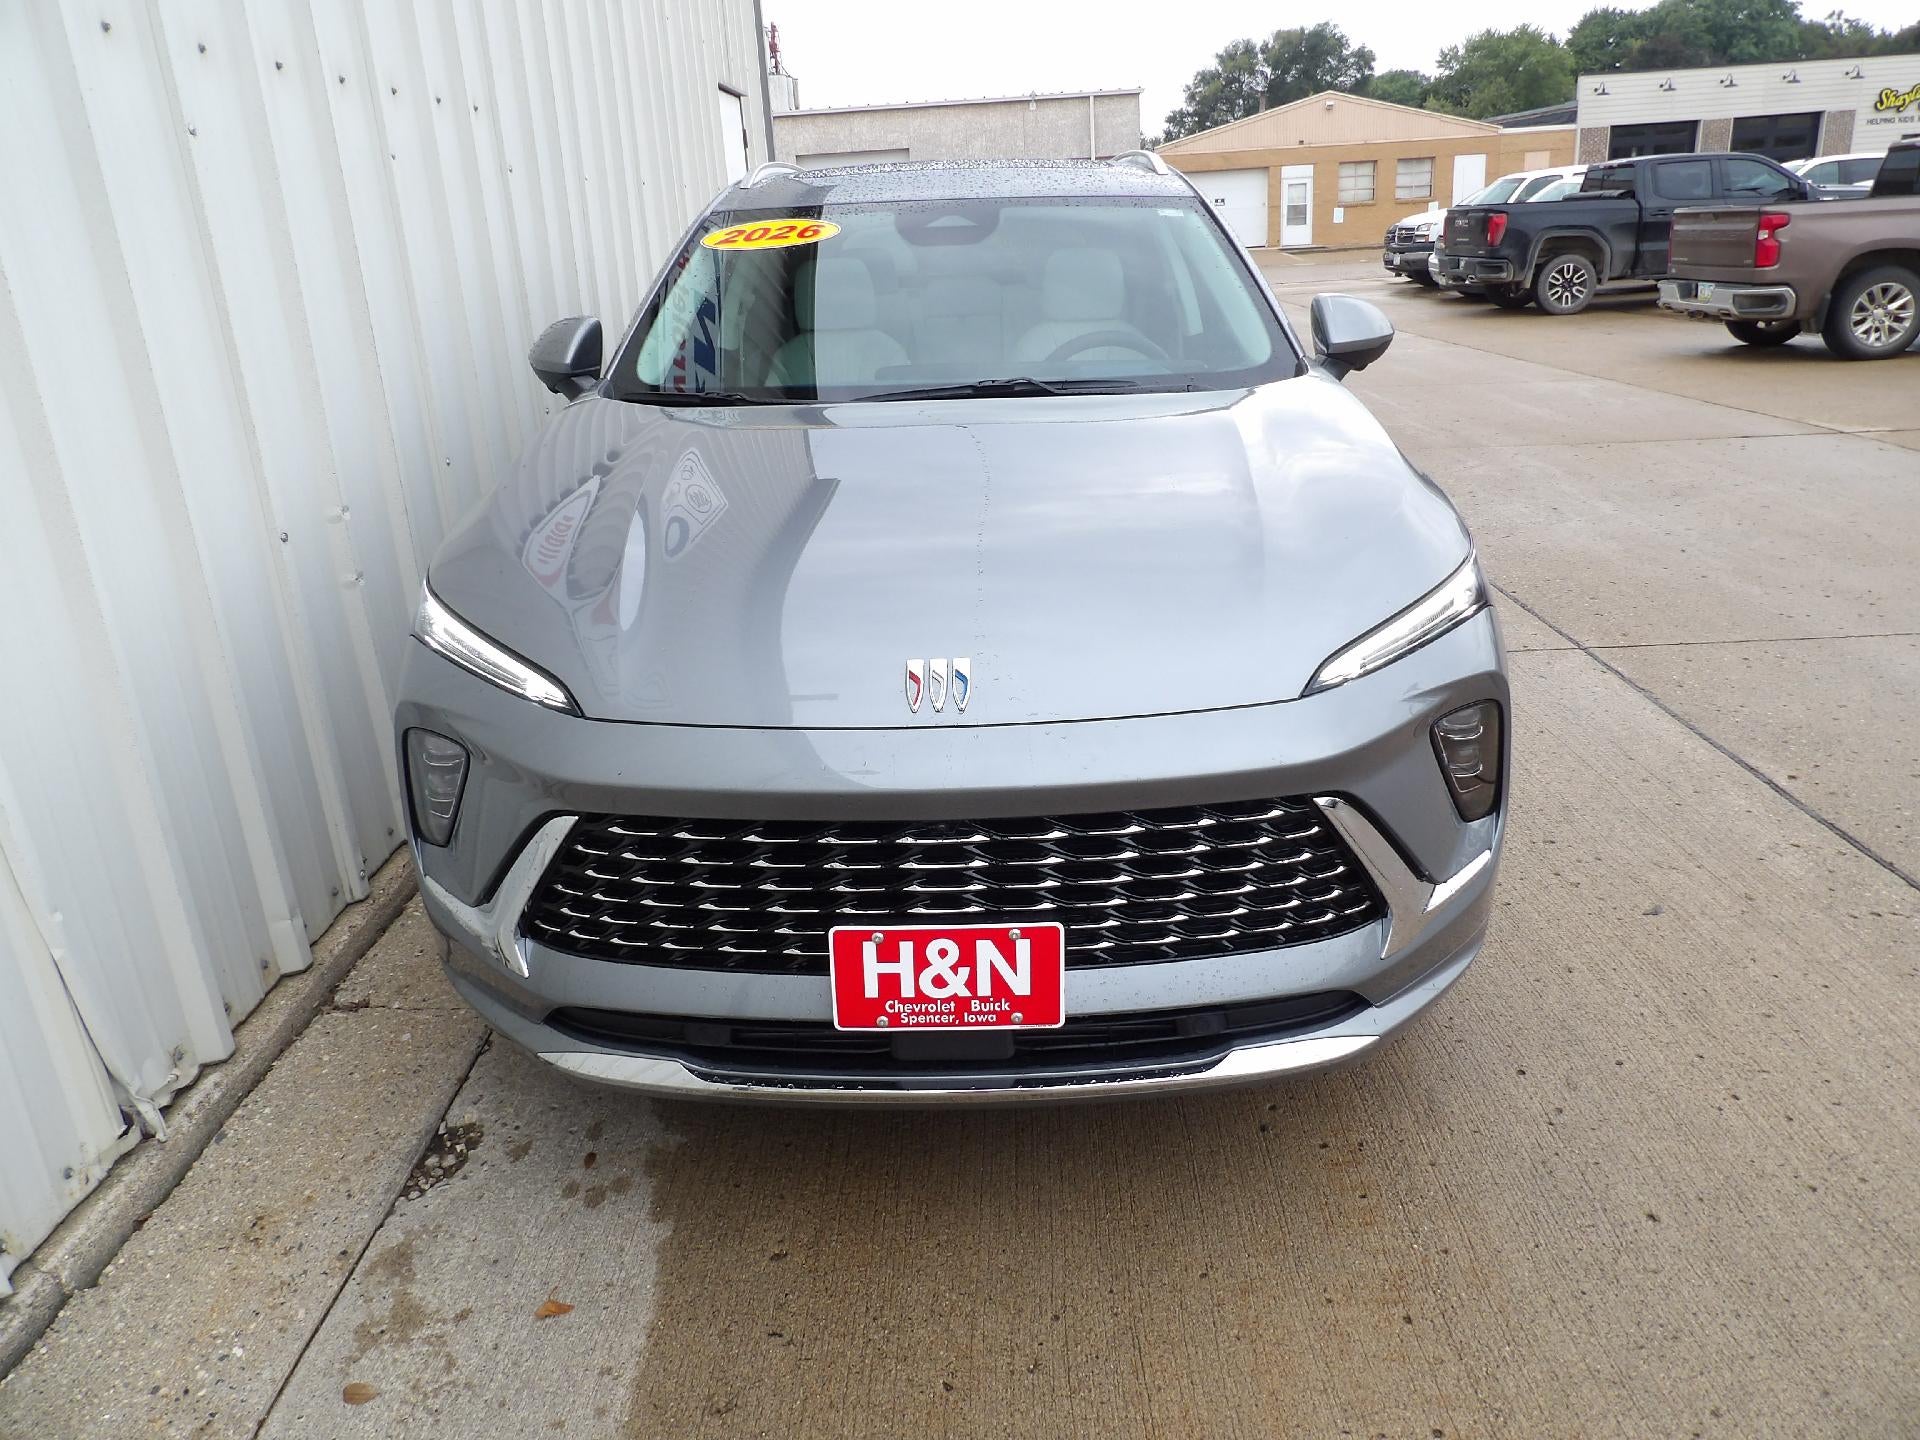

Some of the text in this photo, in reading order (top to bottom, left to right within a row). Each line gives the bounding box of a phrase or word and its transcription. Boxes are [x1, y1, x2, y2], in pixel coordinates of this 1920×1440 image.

[1866, 117, 1895, 125] HELPING
[714, 225, 826, 246] 2026
[862, 938, 1031, 999] H&N
[885, 998, 1010, 1013] Chevrolet Buick
[900, 1012, 996, 1025] Spencer, Iowa
